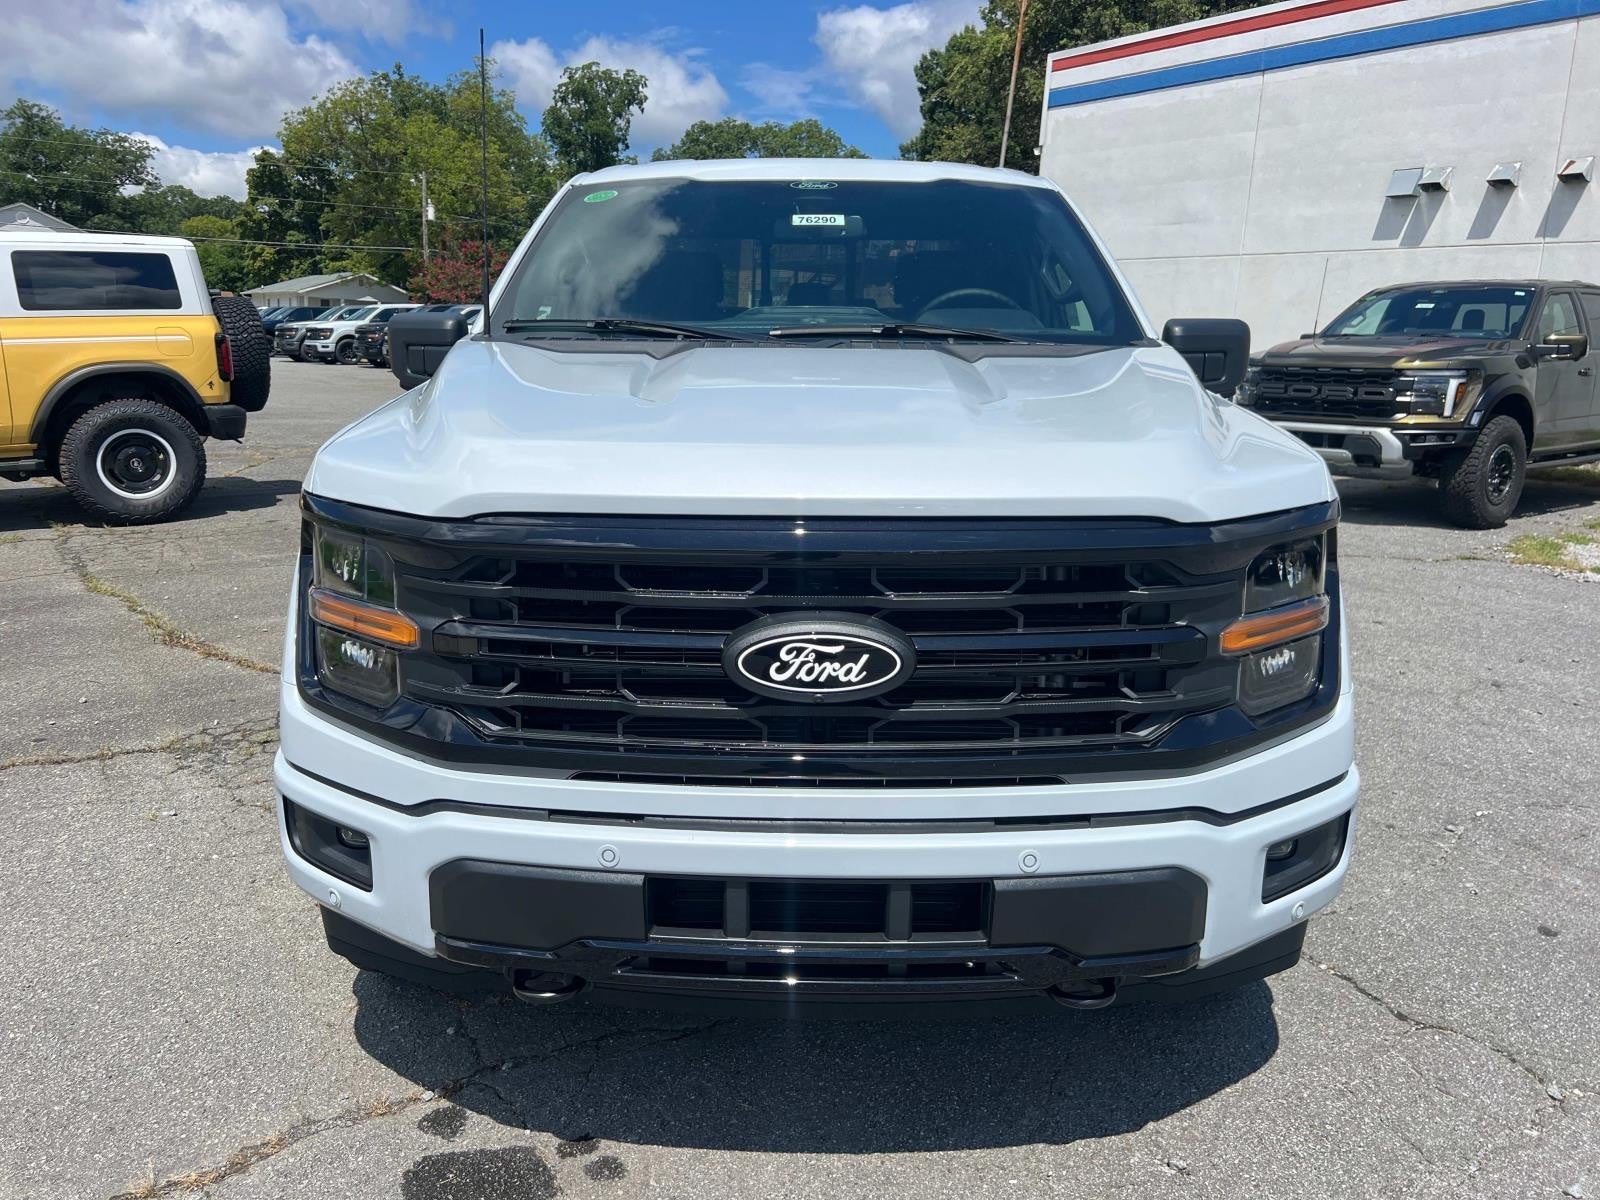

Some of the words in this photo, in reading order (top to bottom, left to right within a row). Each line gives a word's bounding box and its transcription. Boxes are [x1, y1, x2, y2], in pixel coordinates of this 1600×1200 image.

[798, 181, 829, 189] Ford
[797, 216, 836, 224] 76290
[1256, 383, 1397, 401] FORD
[769, 643, 870, 682] Ford
